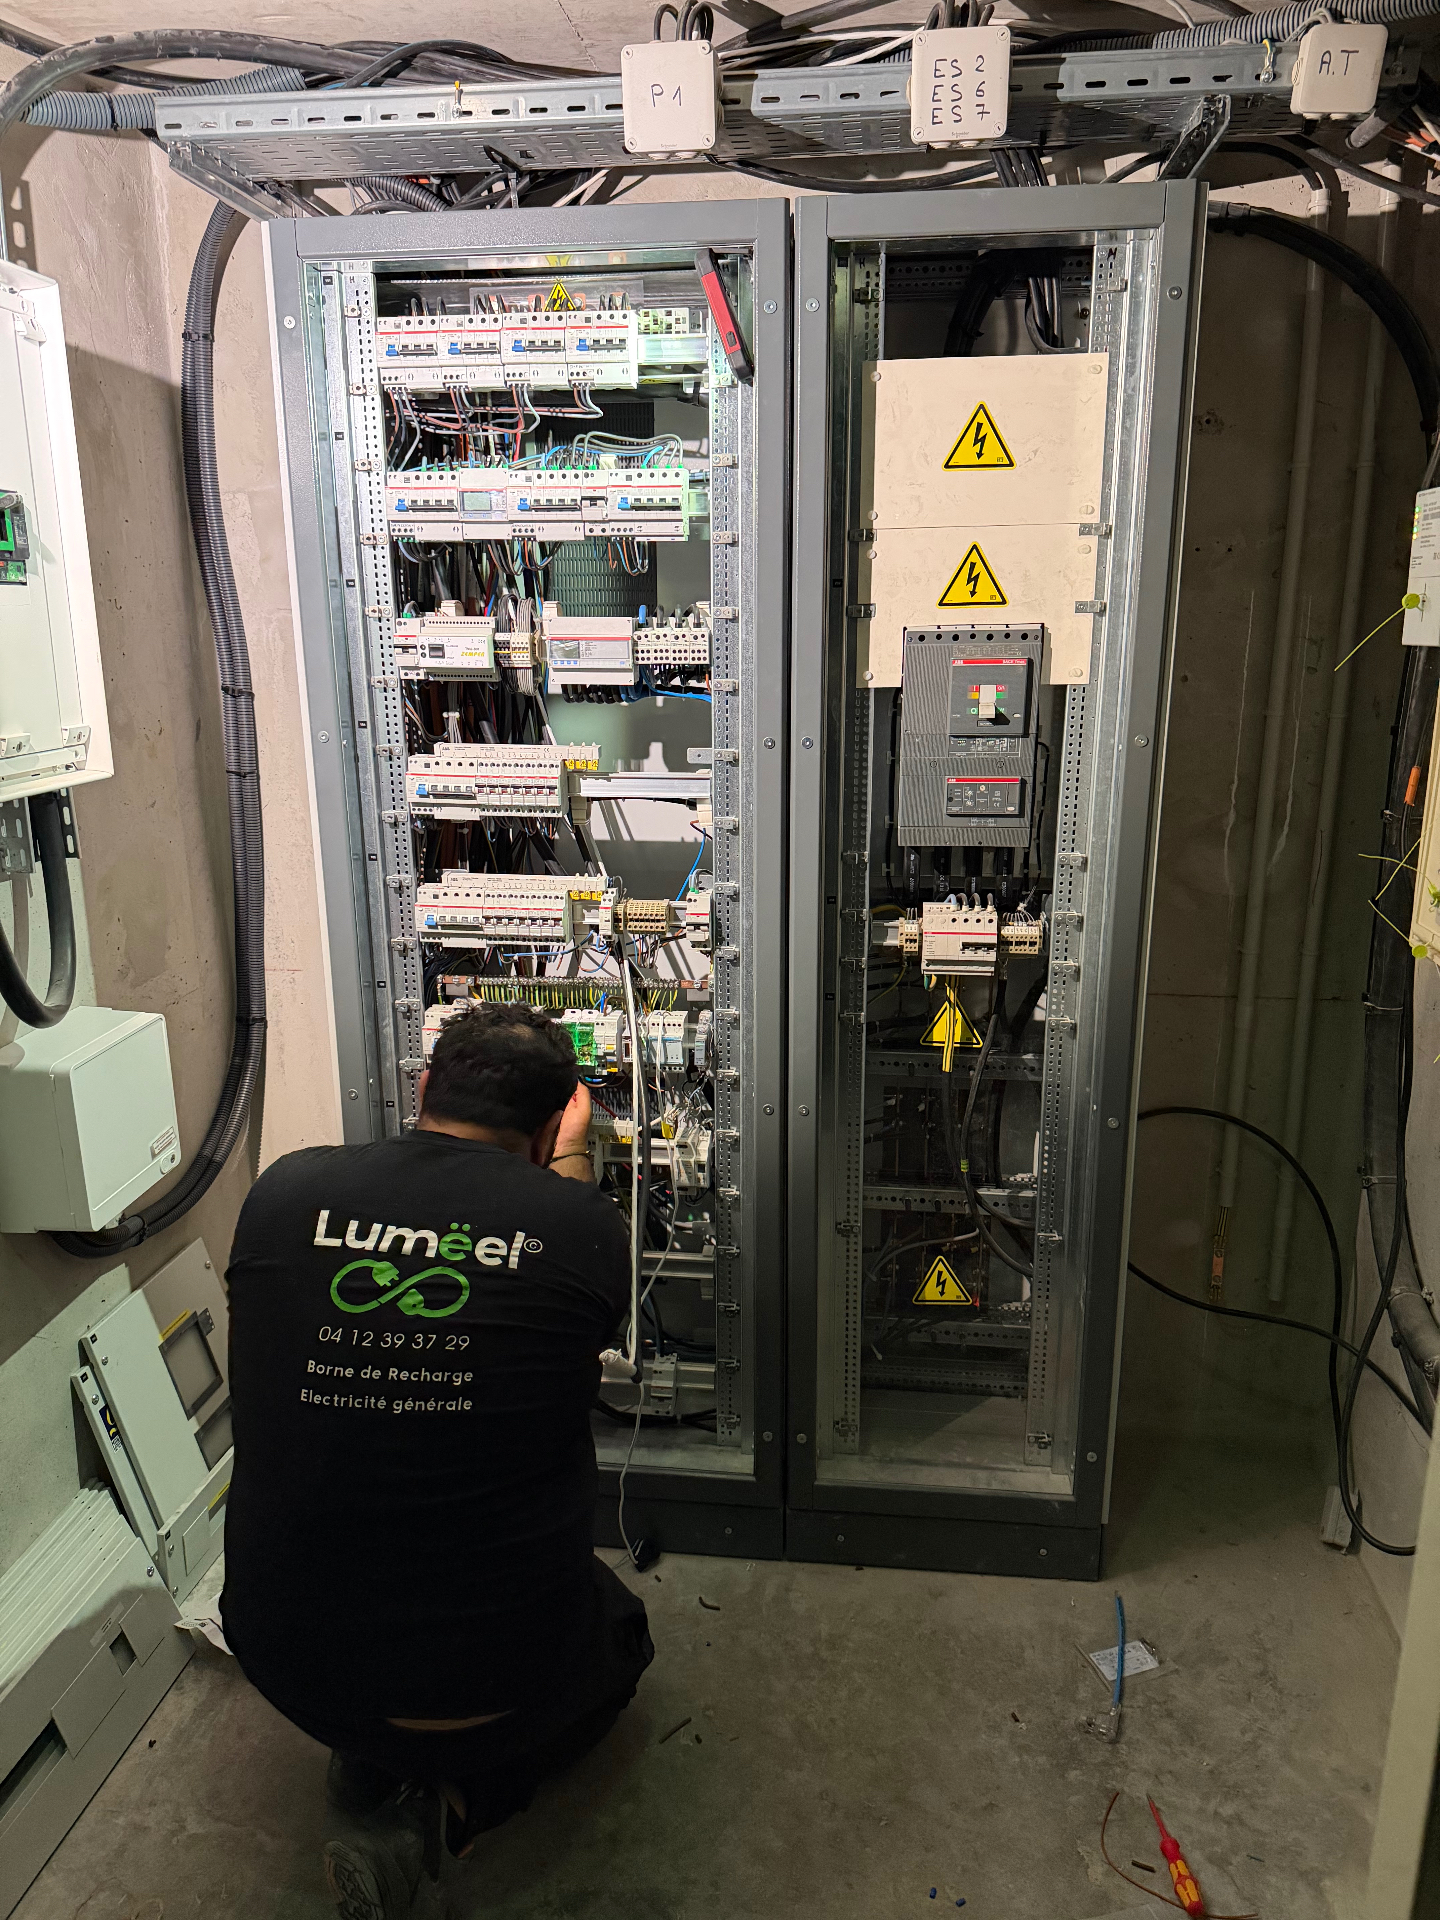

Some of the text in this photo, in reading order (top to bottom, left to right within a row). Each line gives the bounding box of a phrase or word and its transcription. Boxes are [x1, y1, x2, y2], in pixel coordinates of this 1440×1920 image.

[933, 54, 985, 79] ES 2
[1318, 49, 1360, 76] A.T
[931, 80, 986, 103] ES 6
[931, 103, 991, 126] ES 7
[318, 1325, 470, 1351] 04 12 39 37 29
[307, 1359, 474, 1386] Borne de Recharge
[300, 1388, 473, 1414] Electricité générale
